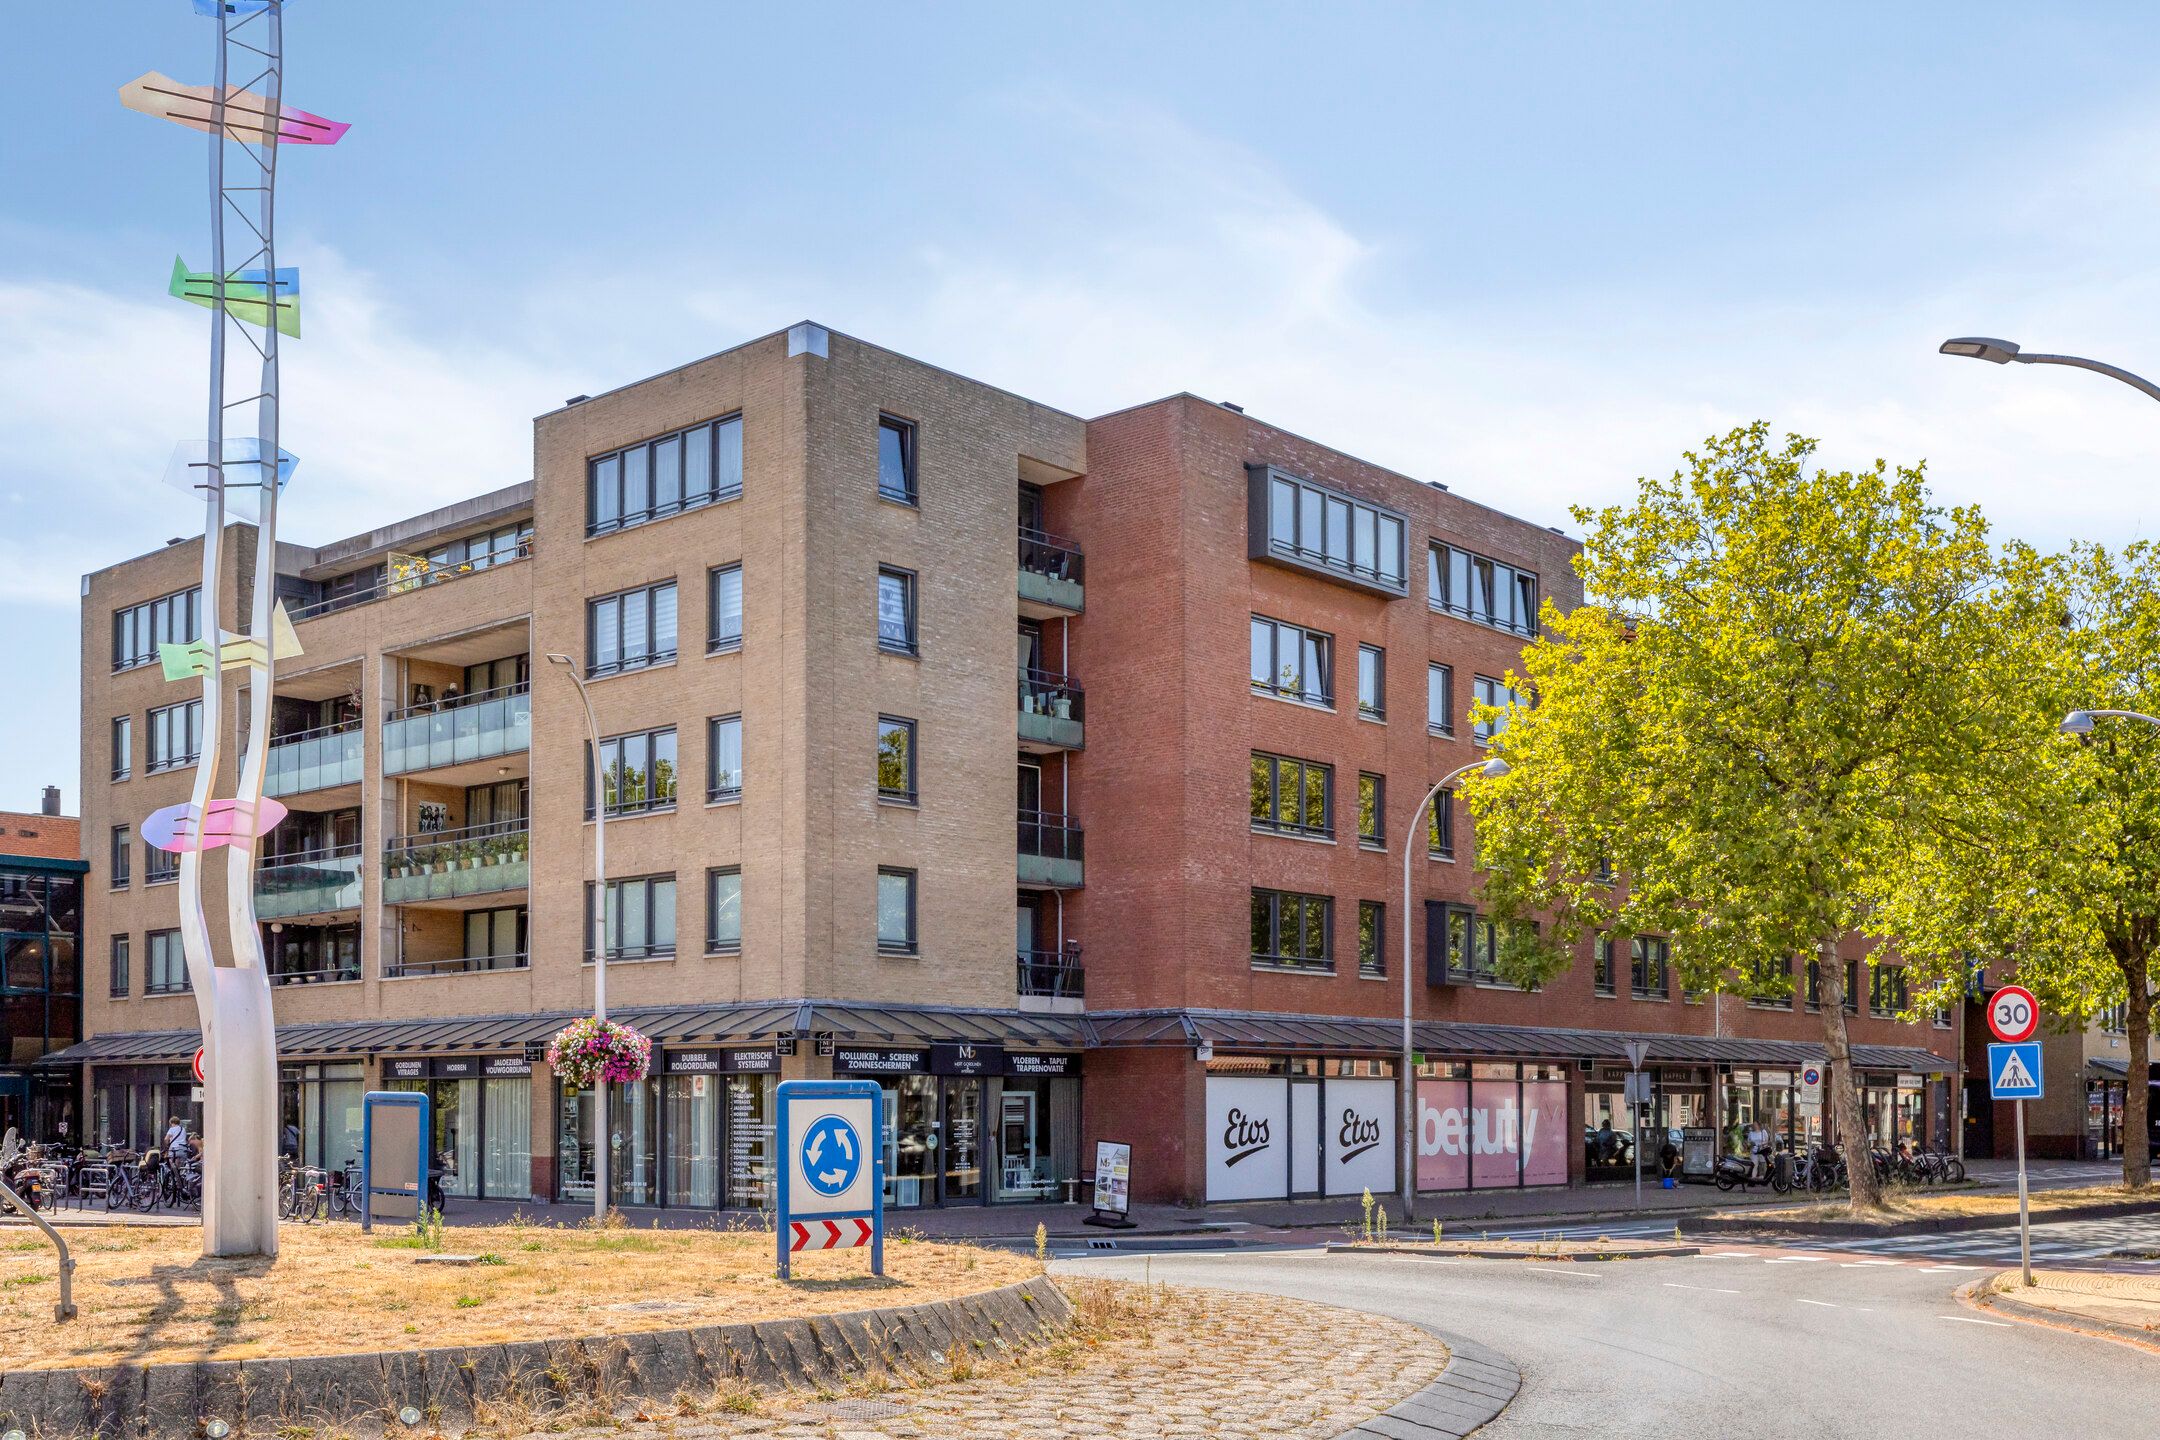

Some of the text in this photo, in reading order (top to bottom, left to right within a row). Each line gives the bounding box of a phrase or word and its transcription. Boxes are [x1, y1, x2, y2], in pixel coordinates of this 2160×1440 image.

[1998, 1004, 2028, 1025] 30
[734, 1052, 772, 1060] ELEKTRISCHE
[839, 1052, 878, 1061] ROLLUIKEN
[889, 1053, 919, 1062] SCREENS
[738, 1060, 769, 1069] SYSTEMEN
[848, 1060, 911, 1069] ZONNESCHERMEN
[1012, 1057, 1040, 1065] VLOEREN
[1049, 1057, 1068, 1065] TAPIJT
[486, 1066, 531, 1074] VOUWGORDIJNEN
[671, 1062, 718, 1070] ROLGORDIJNEN
[1016, 1064, 1064, 1072] TRAPRENOVATIE
[397, 1068, 419, 1076] VITRAGES
[1224, 1108, 1270, 1150] Etos
[1339, 1108, 1380, 1148] Etos
[1418, 1098, 1538, 1171] beauty
